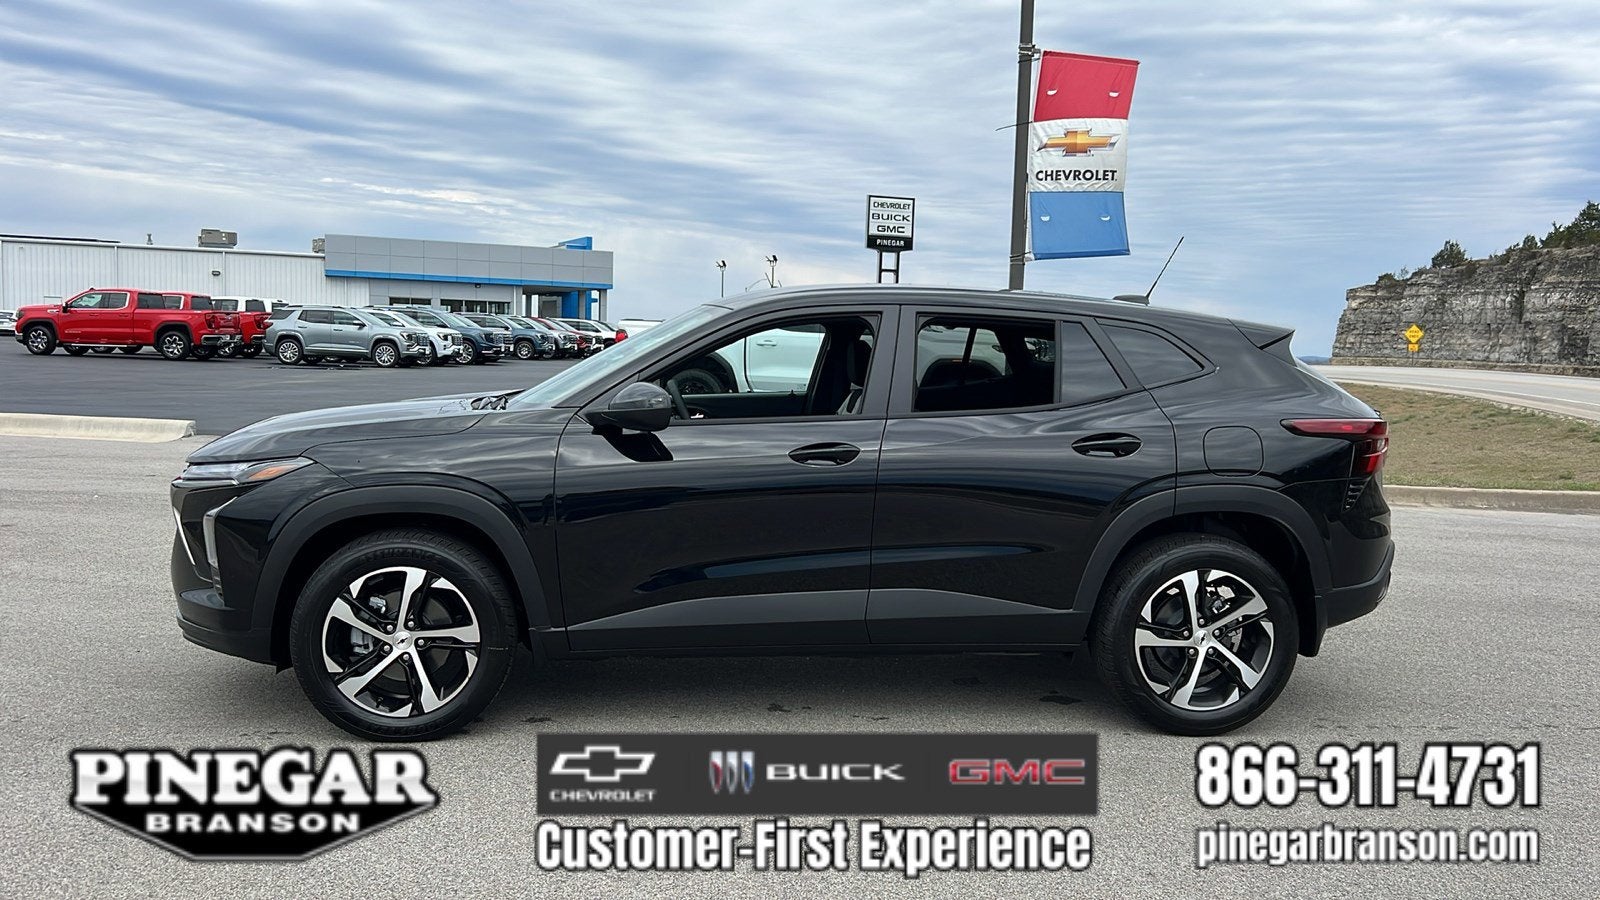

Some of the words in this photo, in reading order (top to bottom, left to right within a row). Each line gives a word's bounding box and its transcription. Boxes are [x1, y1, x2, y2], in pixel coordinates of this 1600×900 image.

[1035, 169, 1118, 182] CHEVROLET
[873, 201, 911, 210] CHEVROLET
[872, 213, 910, 222] BUICK
[877, 225, 905, 233] GMC
[876, 239, 904, 247] PINEGAR
